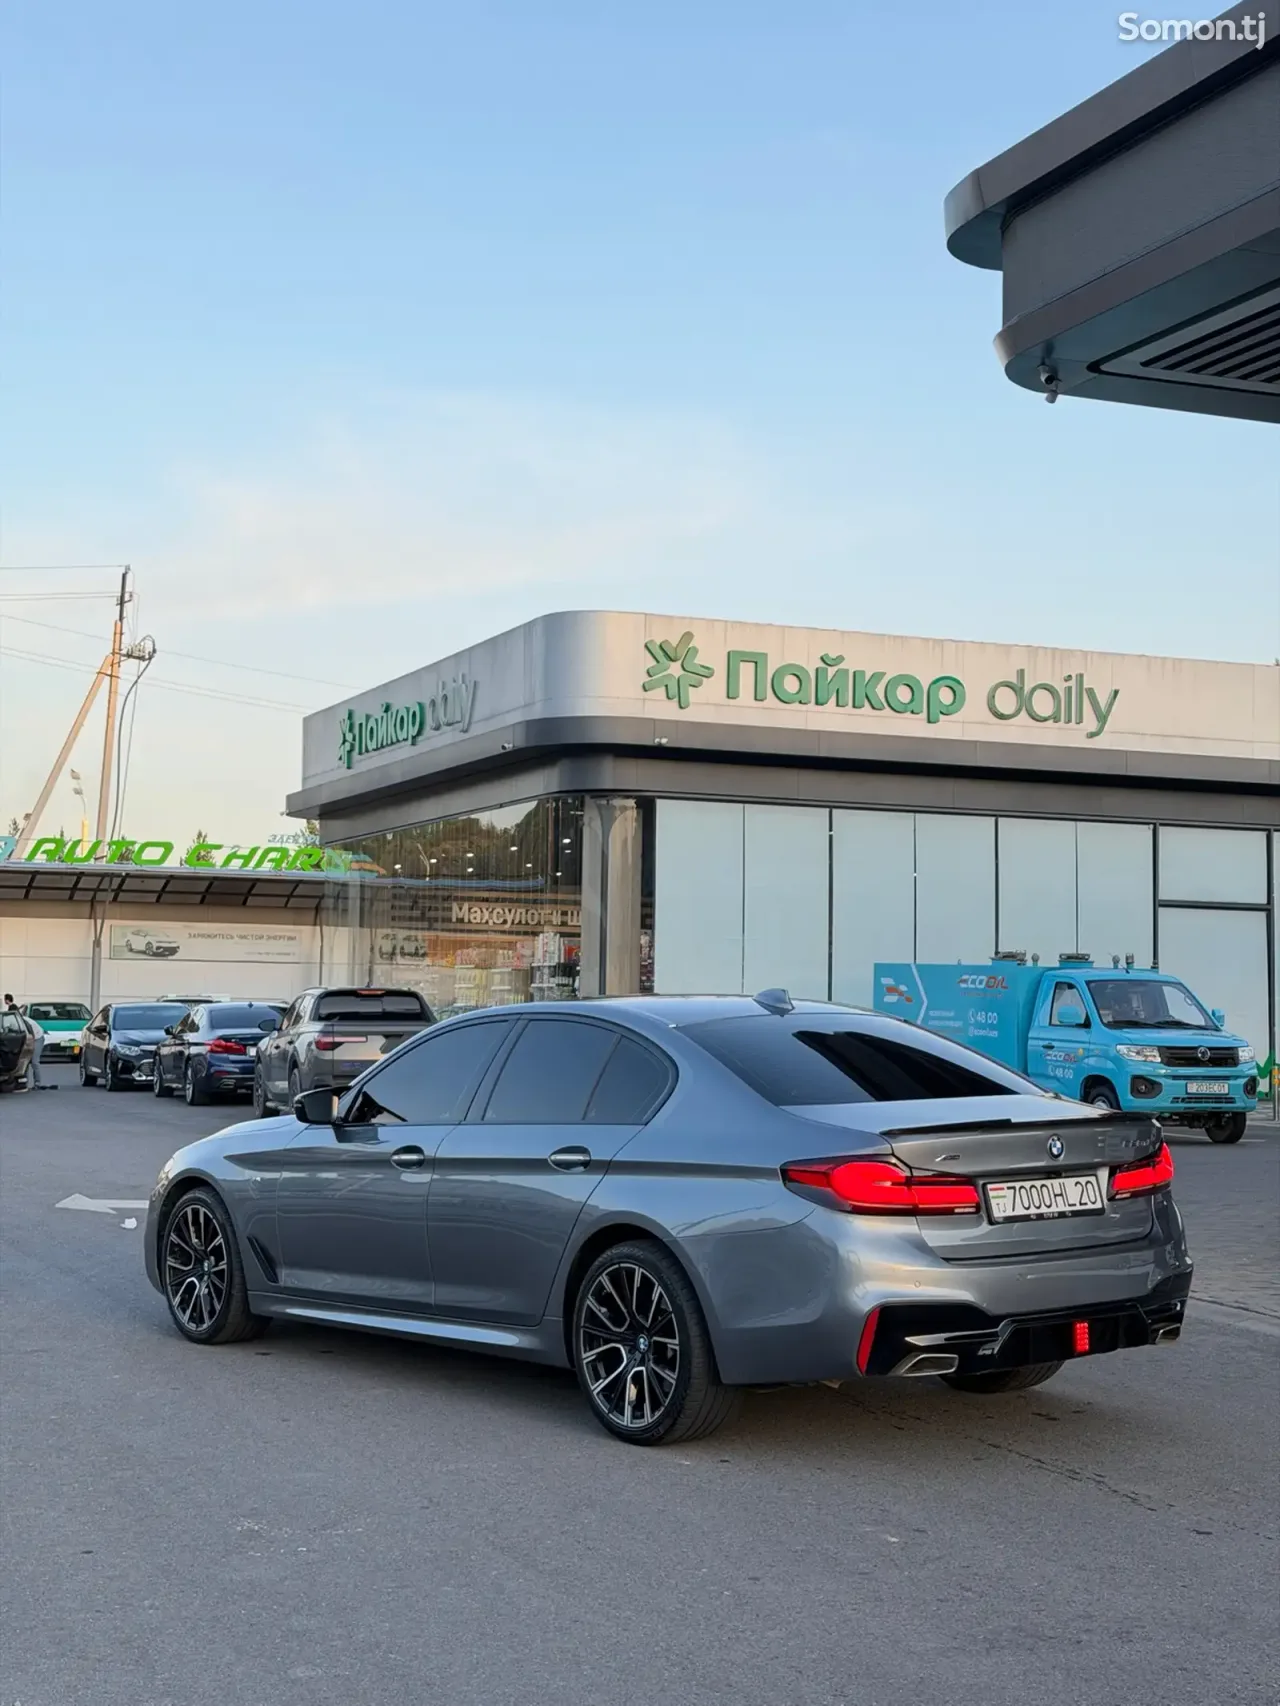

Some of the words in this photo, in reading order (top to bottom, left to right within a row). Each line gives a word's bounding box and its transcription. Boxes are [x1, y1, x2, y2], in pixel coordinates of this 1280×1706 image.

[355, 701, 426, 756] Пайкар
[428, 672, 478, 733] daily
[726, 649, 966, 724] Пайкар
[987, 667, 1120, 739] daily
[25, 837, 174, 866] AUTO
